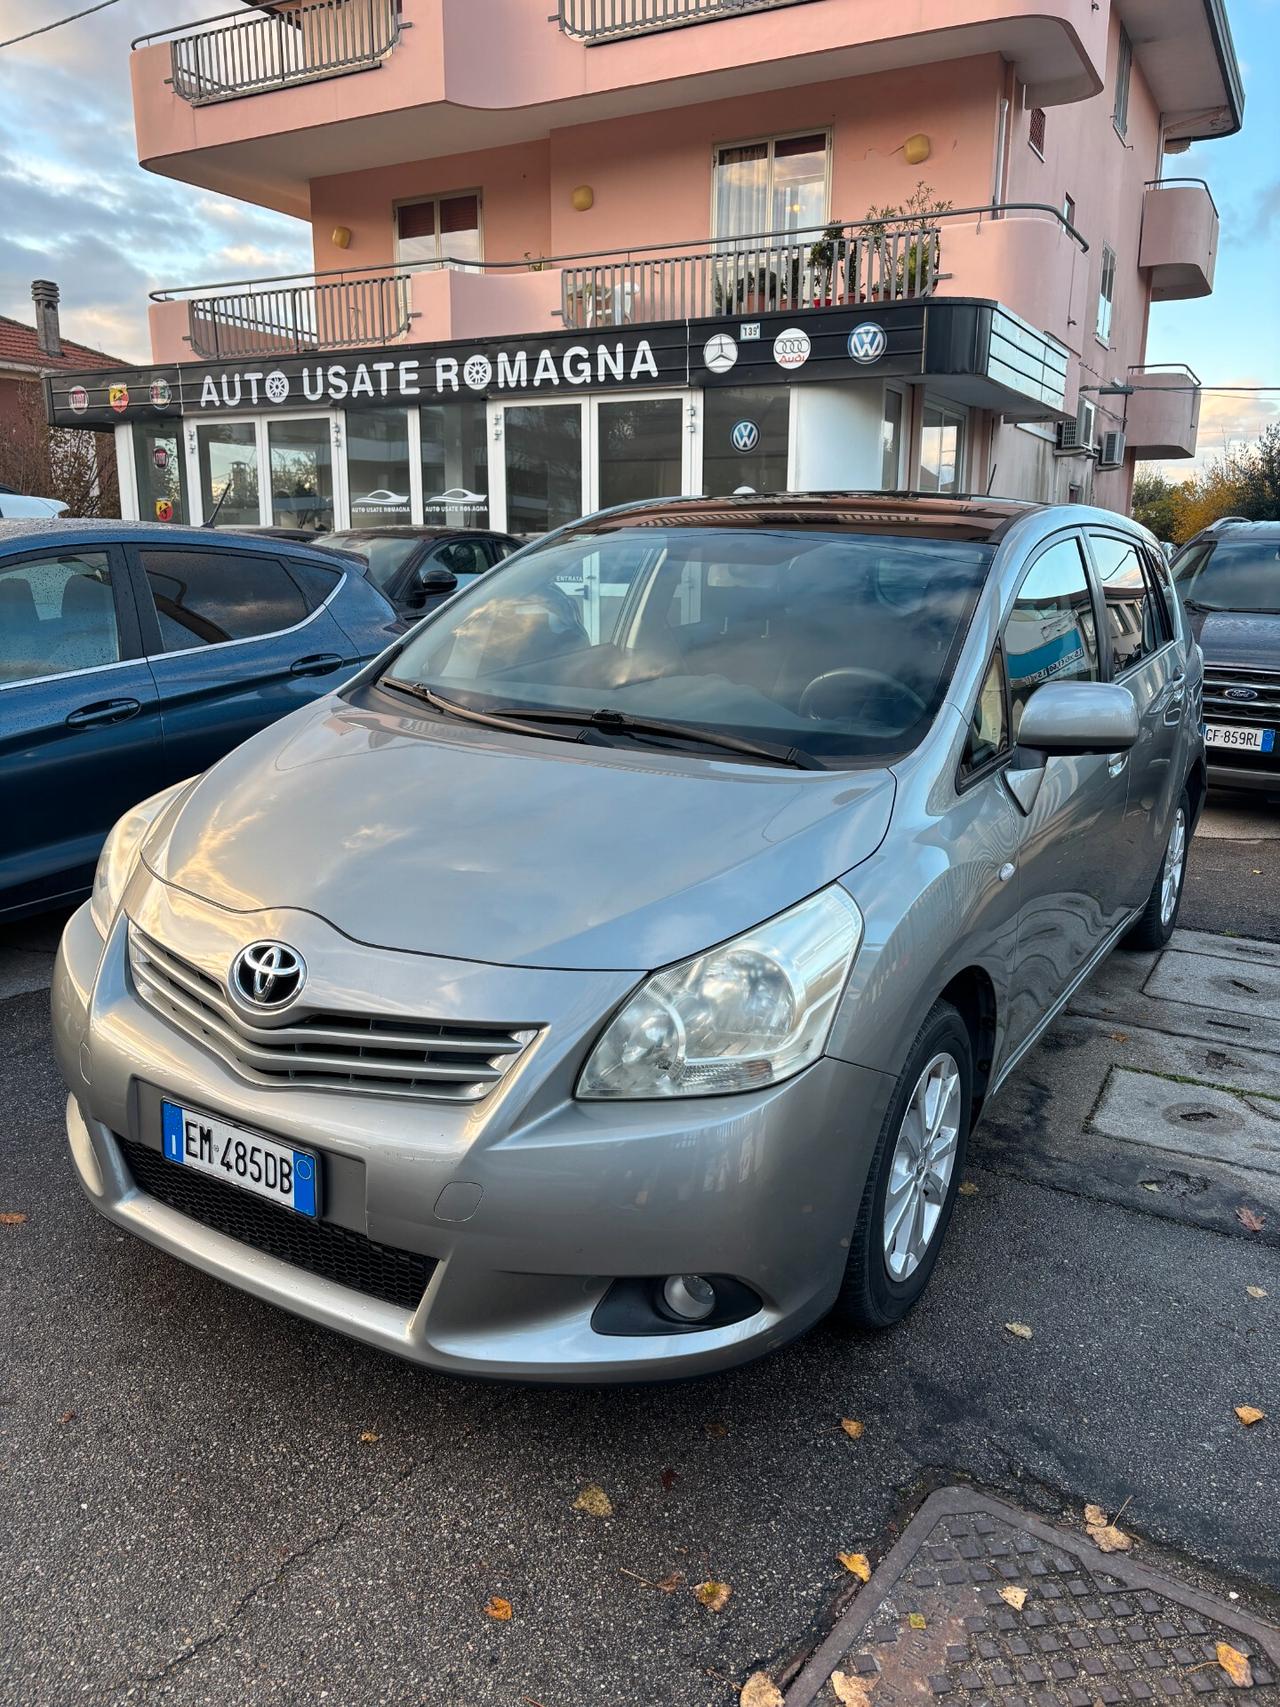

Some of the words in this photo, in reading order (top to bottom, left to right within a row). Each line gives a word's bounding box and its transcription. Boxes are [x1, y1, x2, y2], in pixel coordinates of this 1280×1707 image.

[778, 352, 806, 364] Audi
[200, 370, 290, 408] AUTO
[302, 360, 421, 401] USATE
[435, 339, 659, 393] ROMAGNA
[1231, 689, 1250, 698] Ford
